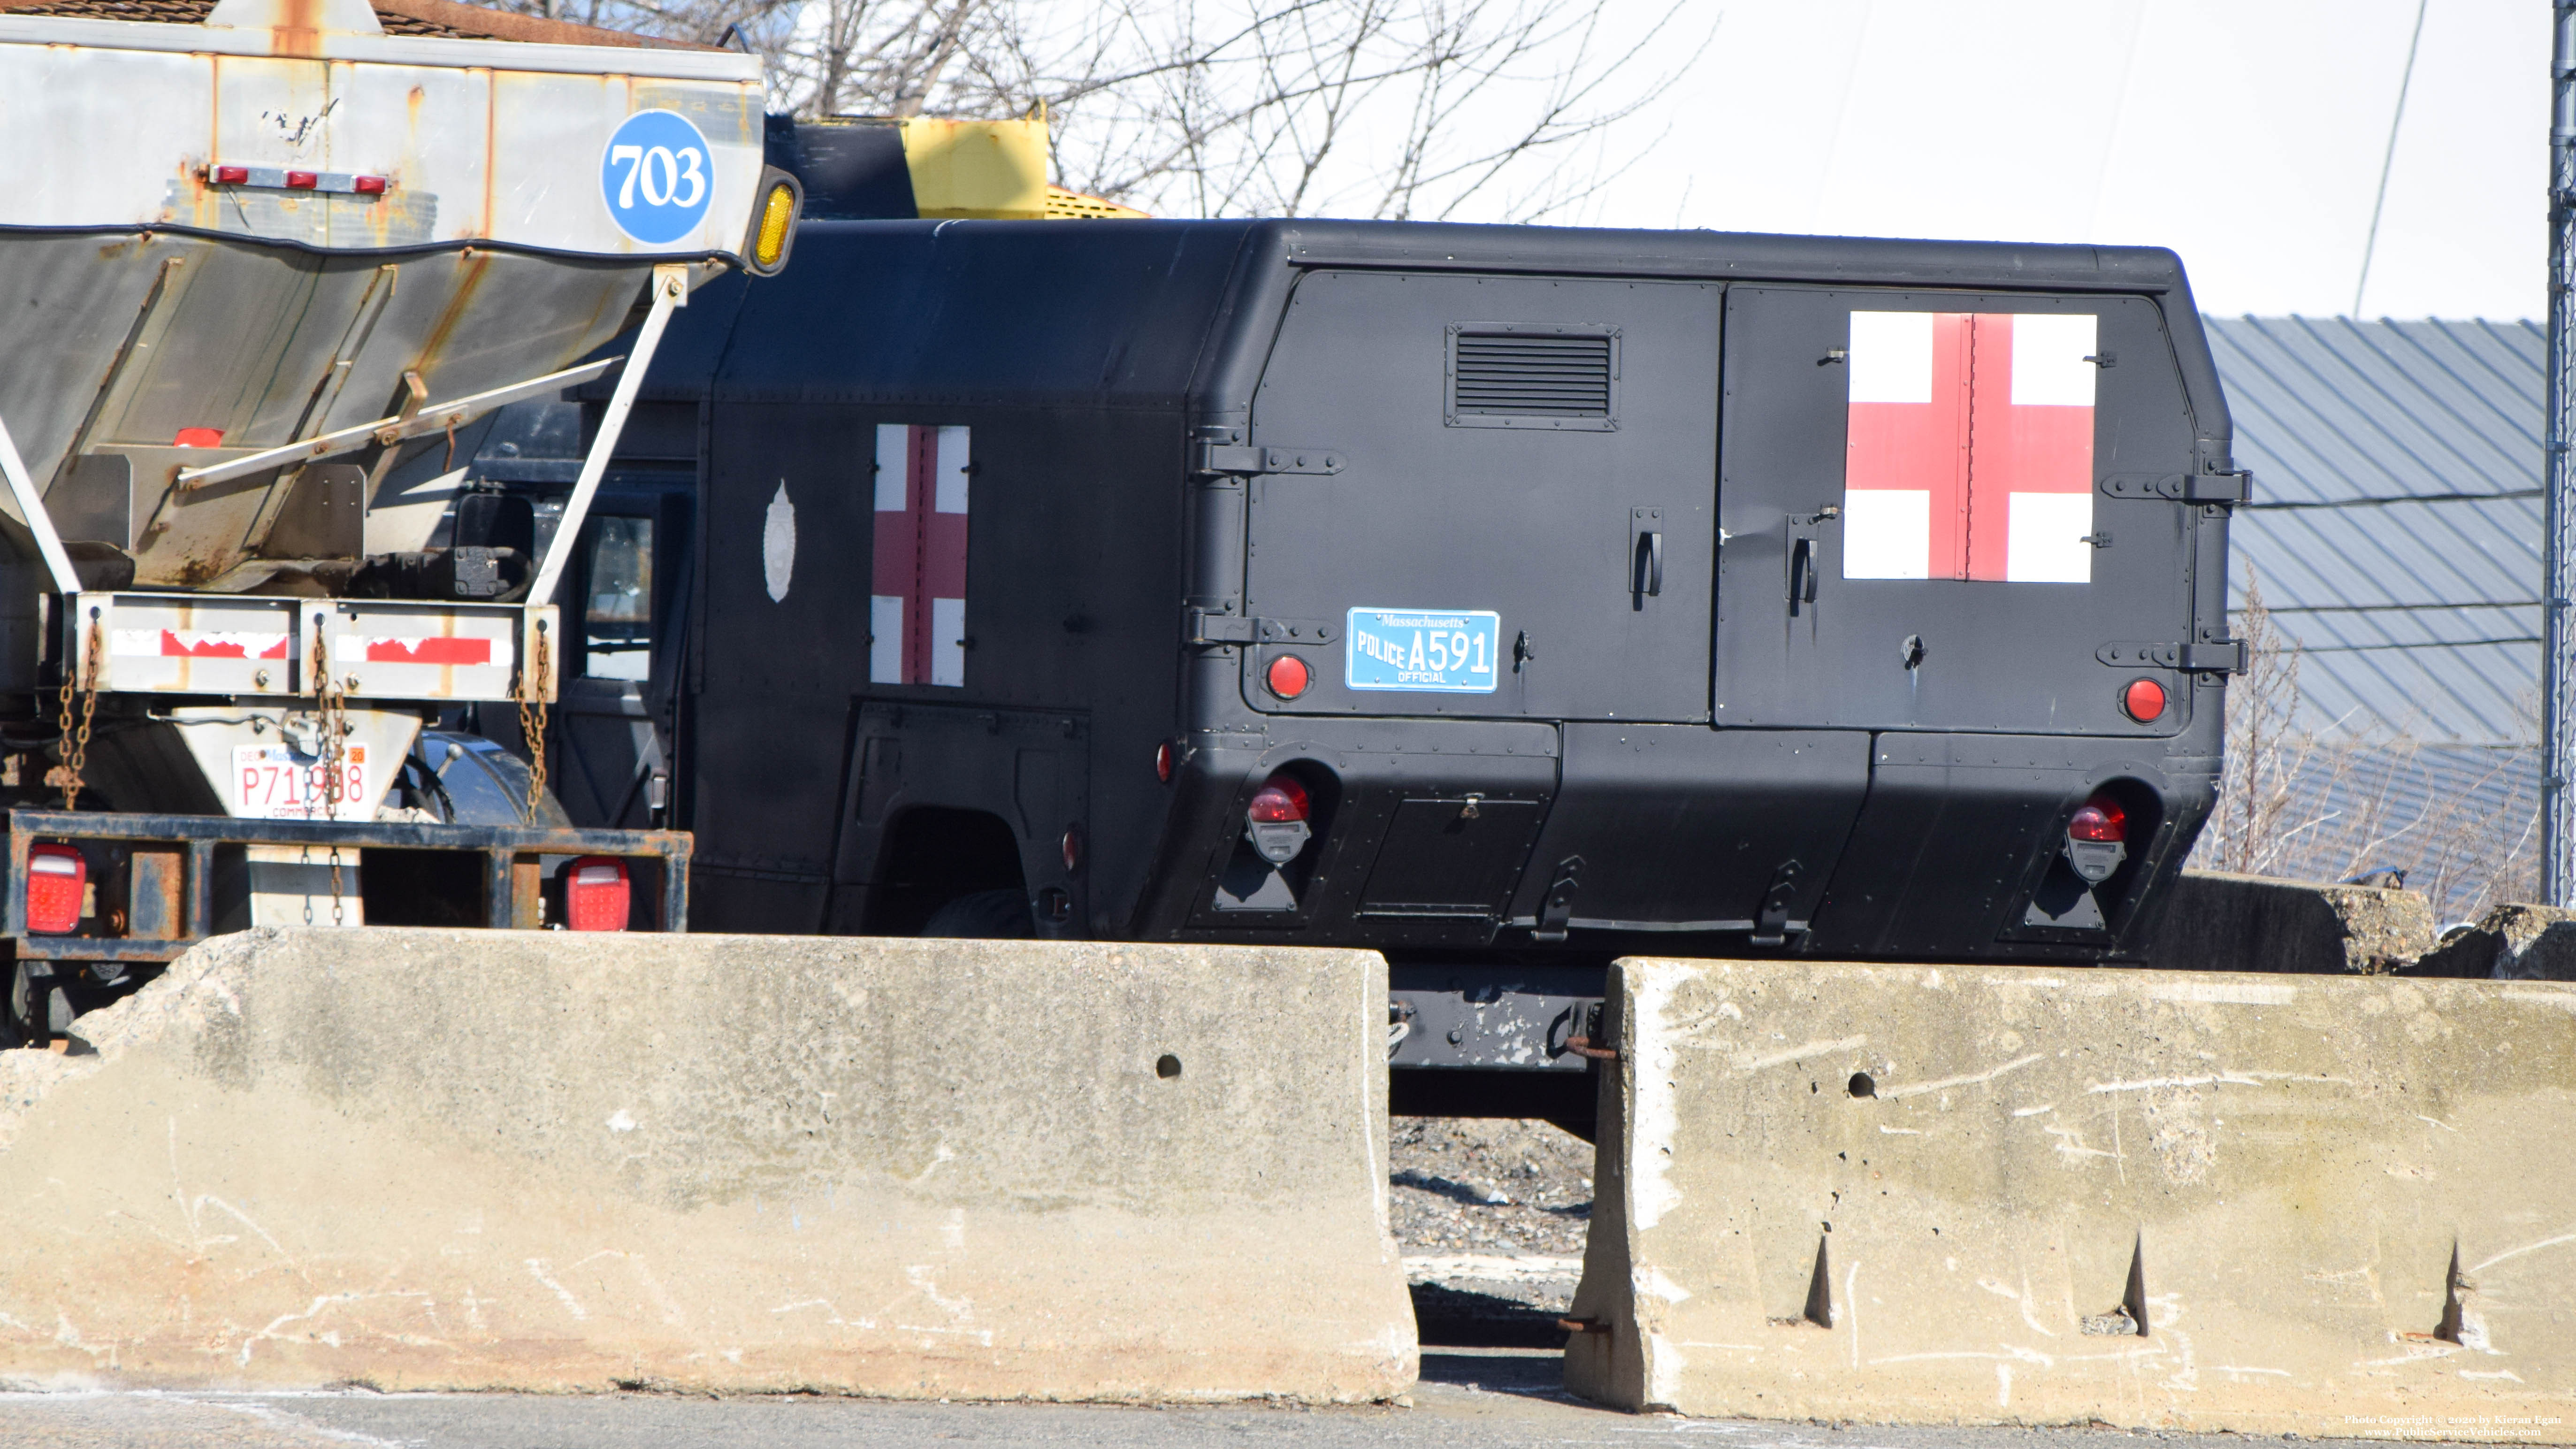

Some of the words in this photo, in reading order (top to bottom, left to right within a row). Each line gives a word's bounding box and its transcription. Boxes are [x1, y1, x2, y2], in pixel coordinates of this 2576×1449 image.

[612, 145, 705, 209] 703
[1382, 614, 1464, 628] Massachusetts
[1358, 630, 1405, 670] POLICE
[1408, 630, 1490, 674] A591
[1398, 671, 1446, 684] OFFICIAL
[352, 751, 363, 761] 20
